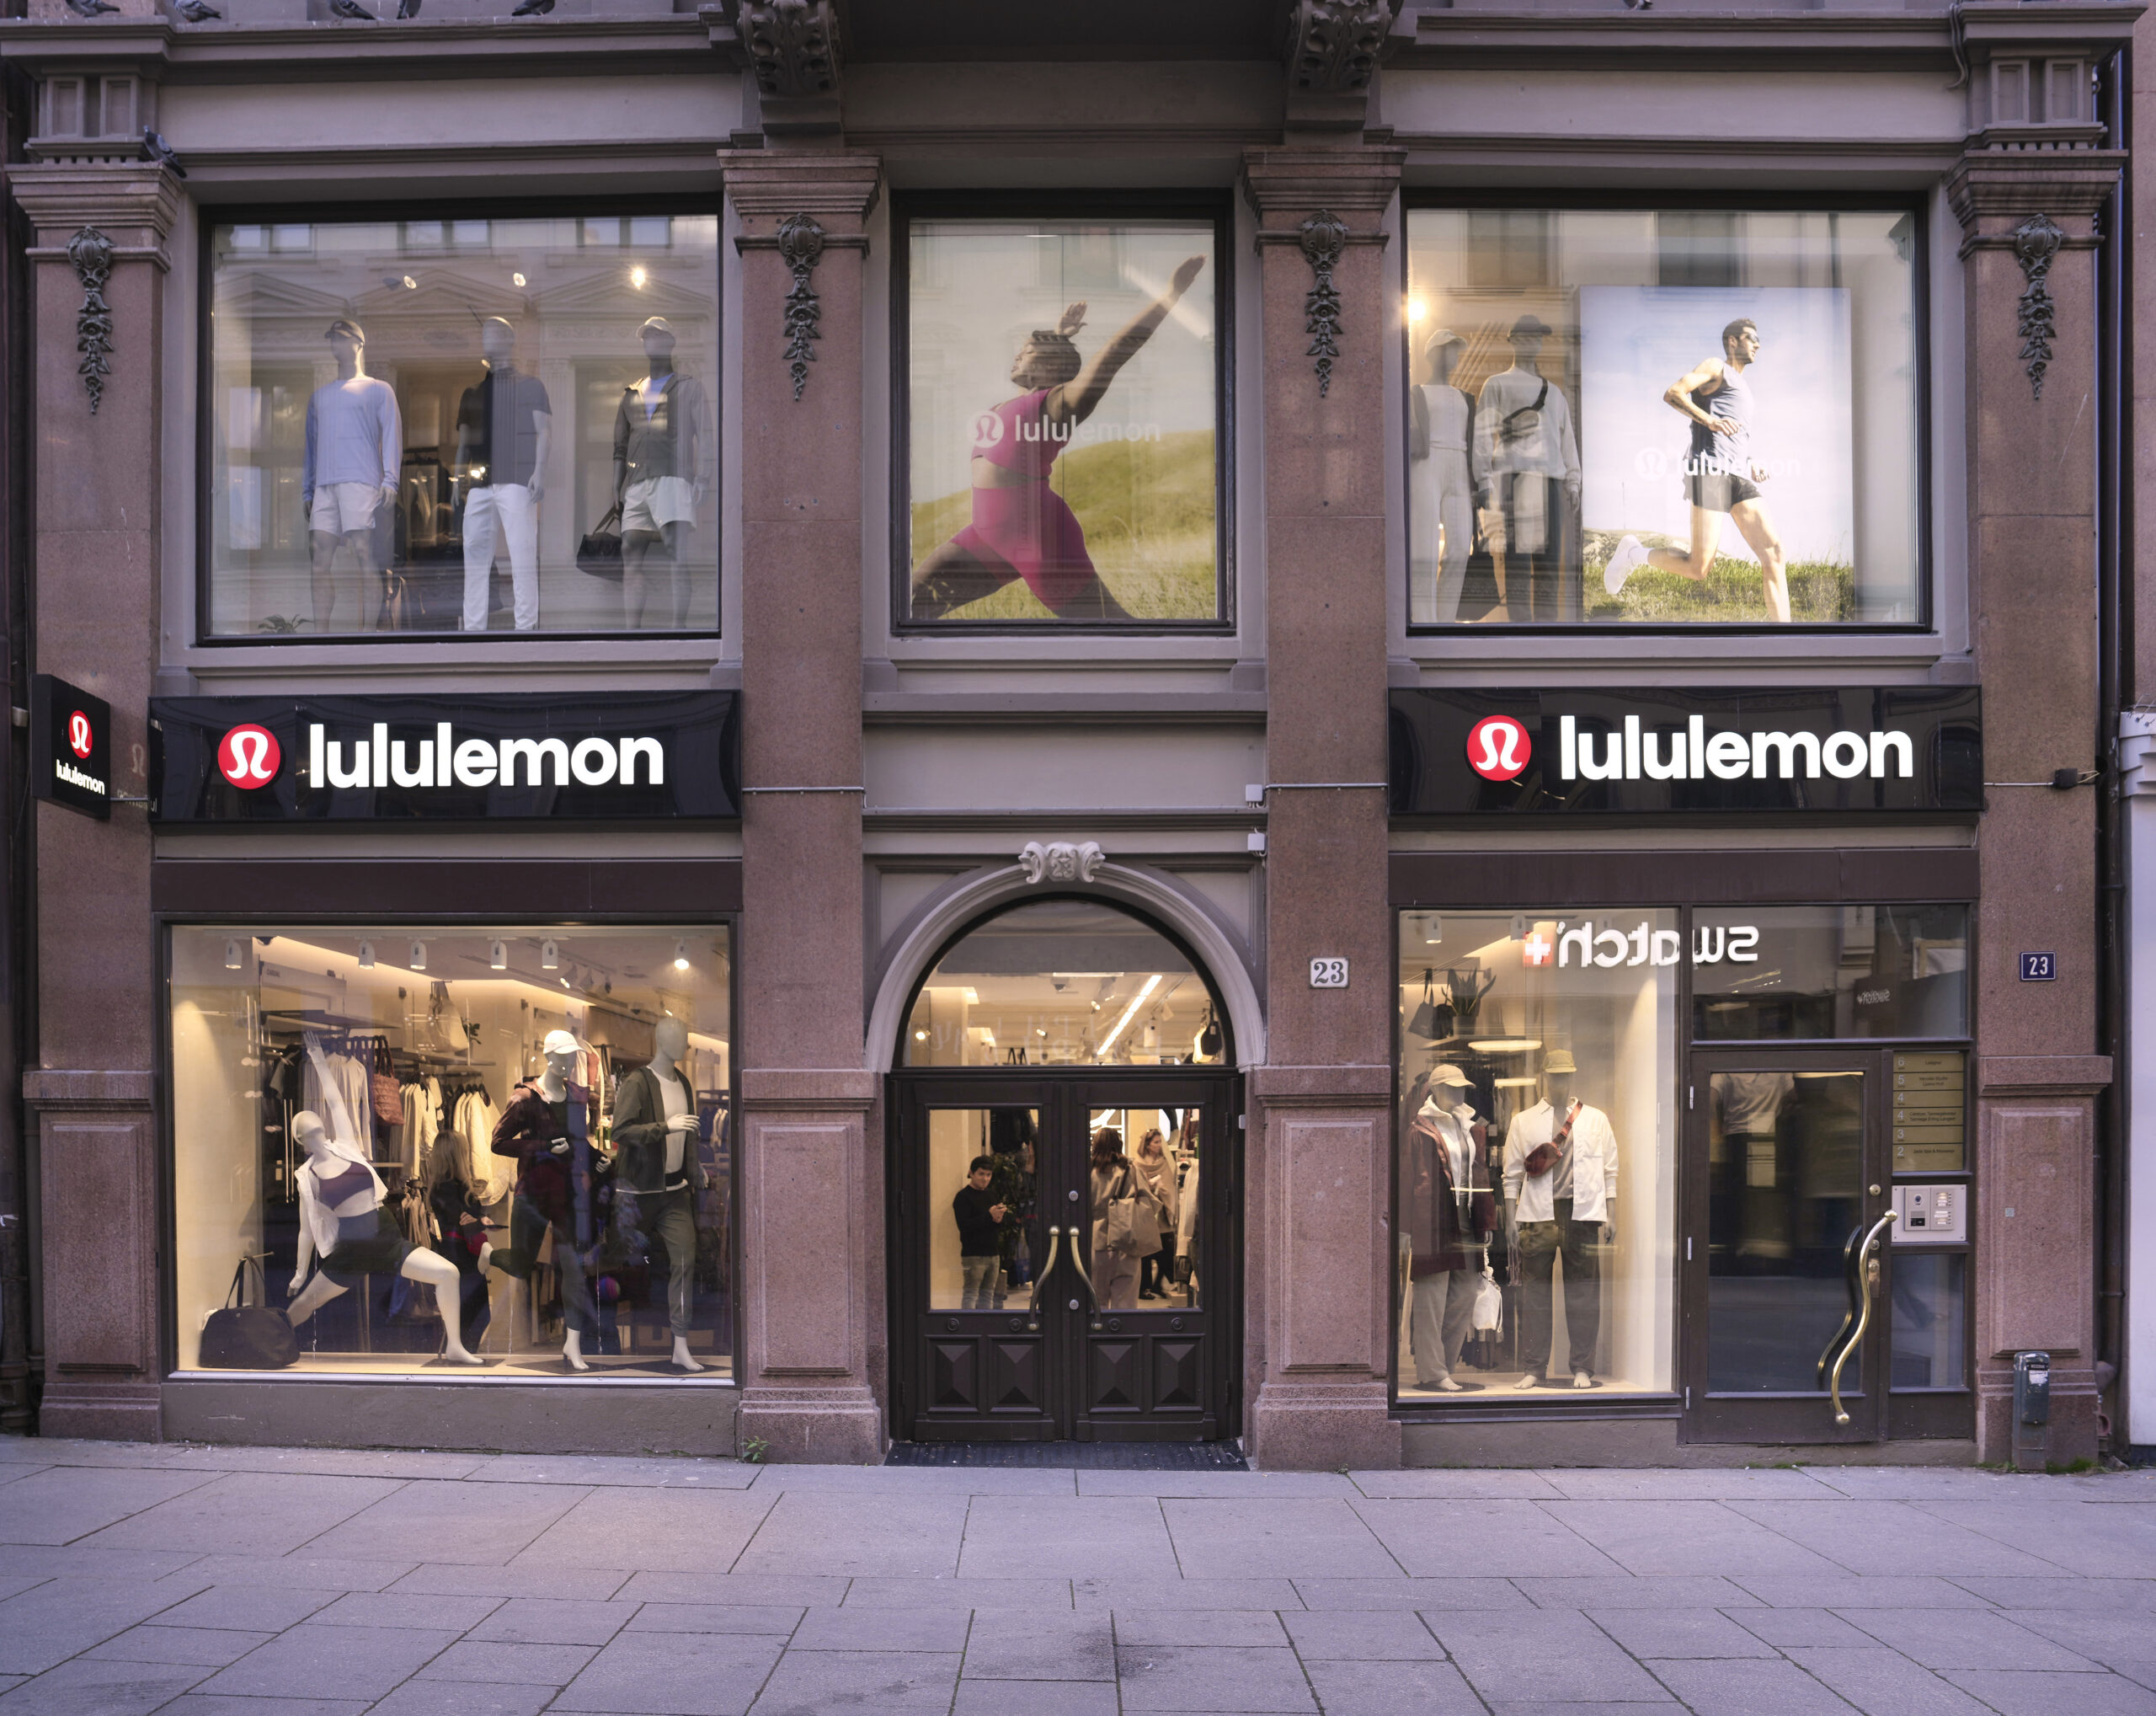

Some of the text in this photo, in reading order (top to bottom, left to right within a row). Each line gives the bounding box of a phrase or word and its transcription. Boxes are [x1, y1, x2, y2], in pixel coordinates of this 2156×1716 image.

[1016, 414, 1161, 442] lululemon
[310, 722, 664, 789] lululemon
[1561, 714, 1913, 780] lululemon
[56, 758, 105, 795] lululemon
[1050, 859, 1075, 878] 23
[1314, 961, 1344, 984] 23
[2029, 956, 2048, 976] 23
[1897, 1057, 1905, 1066] 6
[1897, 1075, 1905, 1084] 5
[1897, 1093, 1904, 1102] 4
[1897, 1110, 1904, 1120] 4
[1897, 1129, 1904, 1139] 3
[1897, 1146, 1904, 1157] 2
